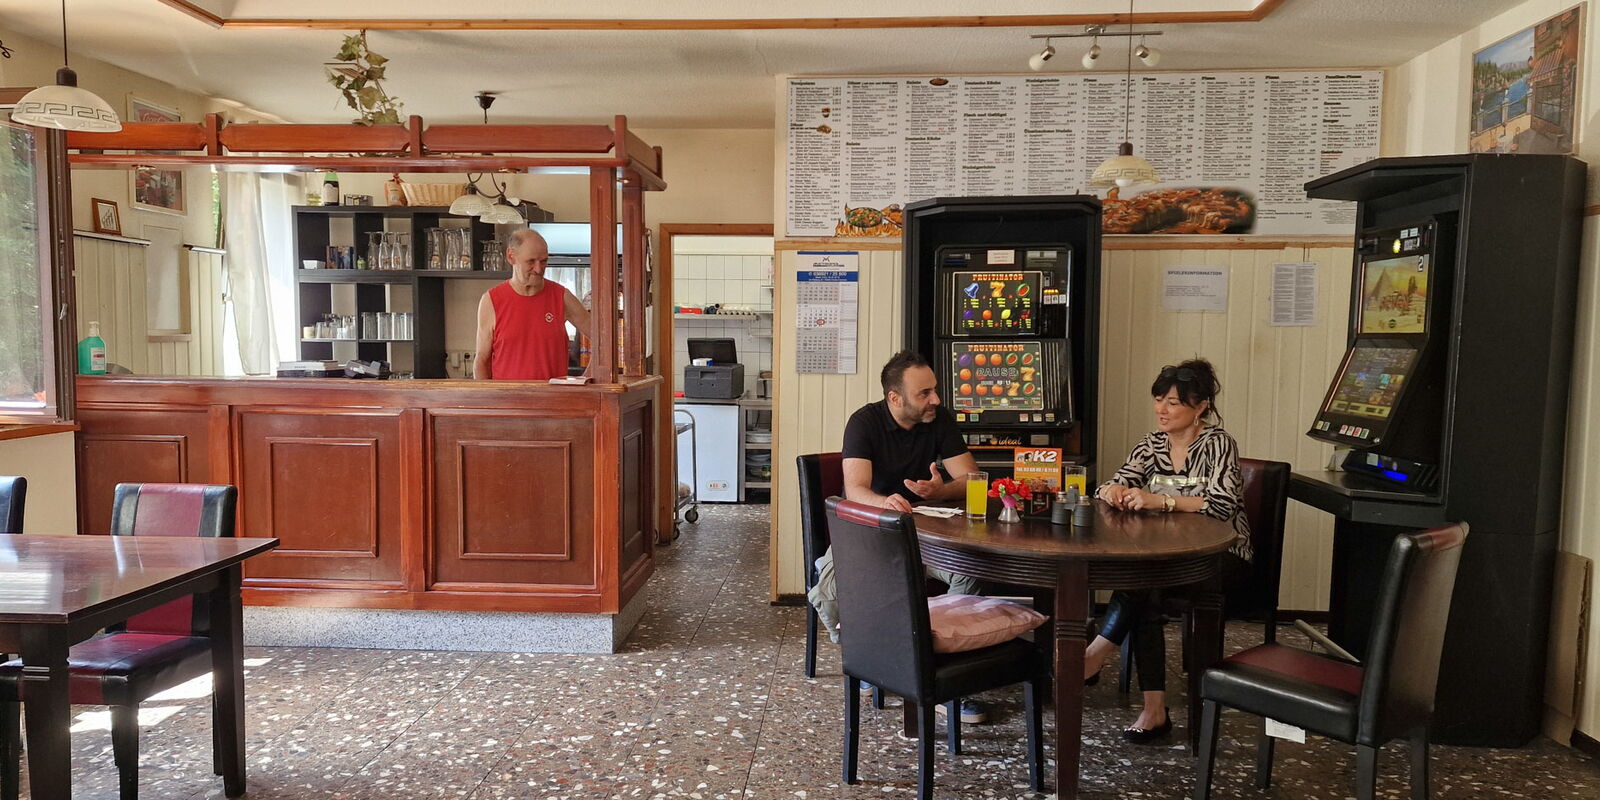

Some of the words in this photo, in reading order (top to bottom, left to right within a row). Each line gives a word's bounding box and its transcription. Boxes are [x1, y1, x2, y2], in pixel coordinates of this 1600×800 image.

[1418, 255, 1424, 272] 2
[972, 273, 1024, 281] FRUITINATOR
[967, 344, 1025, 352] FRUITINATOR
[998, 436, 1022, 445] ideal
[1033, 450, 1058, 463] K2
